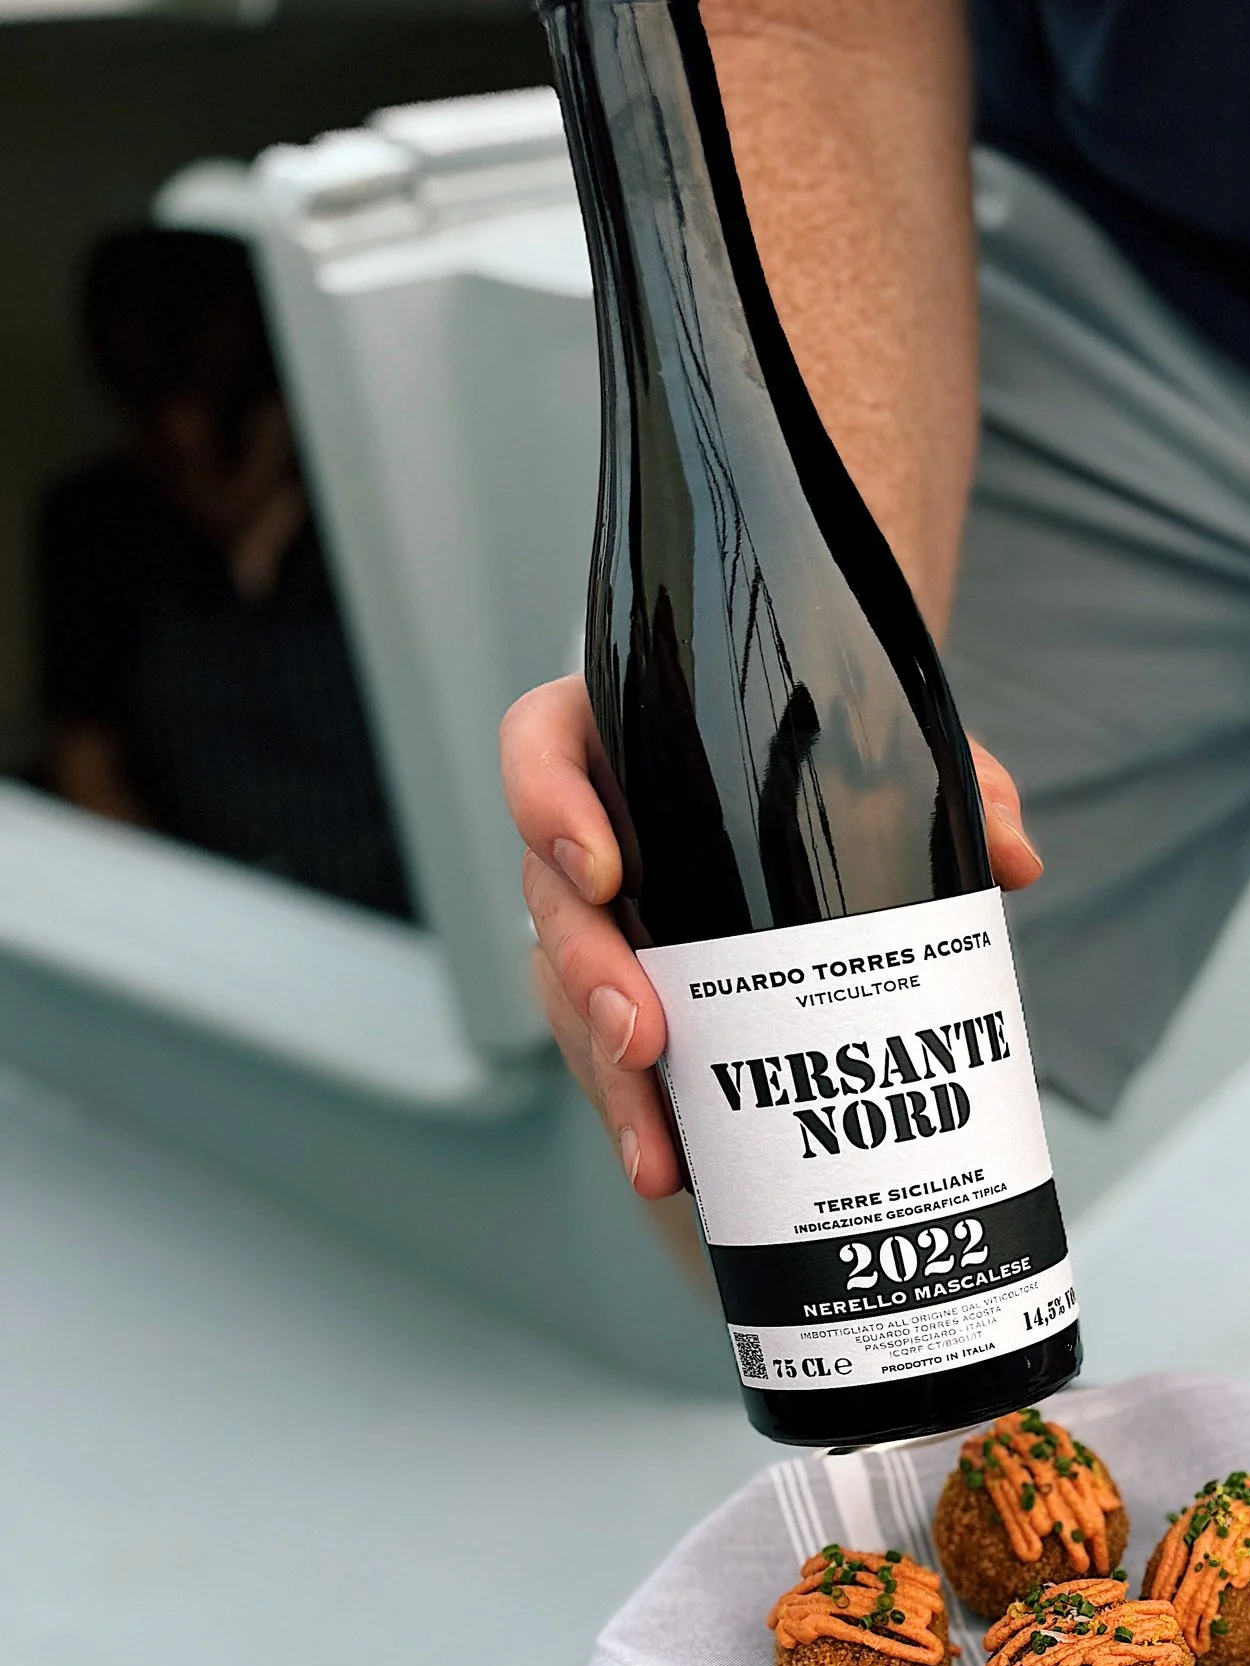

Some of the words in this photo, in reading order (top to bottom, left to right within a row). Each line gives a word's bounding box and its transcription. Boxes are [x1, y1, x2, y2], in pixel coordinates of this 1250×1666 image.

[689, 968, 805, 999] EDUARDO
[812, 948, 915, 981] TORRES
[923, 931, 991, 961] ACOSTA
[796, 975, 921, 1008] VITICULTORE
[710, 1010, 1011, 1111] VERSANTE
[792, 1082, 971, 1159] NORD
[794, 1213, 882, 1234] INDICAZIONE
[886, 1193, 970, 1219] GEOGRAFICA
[972, 1182, 1007, 1200] TIPICA
[813, 1192, 882, 1214] TERRE
[888, 1168, 985, 1202] SICILIANE
[839, 1218, 989, 1291] 2022
[803, 1291, 907, 1318] NERELLO
[914, 1256, 1032, 1302] MASCALESE
[1023, 1295, 1066, 1331] 14,5%
[1064, 1286, 1077, 1310] VO
[800, 1322, 884, 1340] IMBOTTIGLIATO
[855, 1328, 911, 1344] EDUARDO
[914, 1318, 960, 1334] TORRES
[962, 1306, 1003, 1323] ACOSTA
[864, 1327, 957, 1352] PASSOPISCIARO
[966, 1317, 998, 1332] ITALIA
[772, 1358, 798, 1379] 75
[802, 1357, 832, 1378] CL
[881, 1355, 943, 1374] PRODOTTO
[946, 1351, 959, 1362] IN
